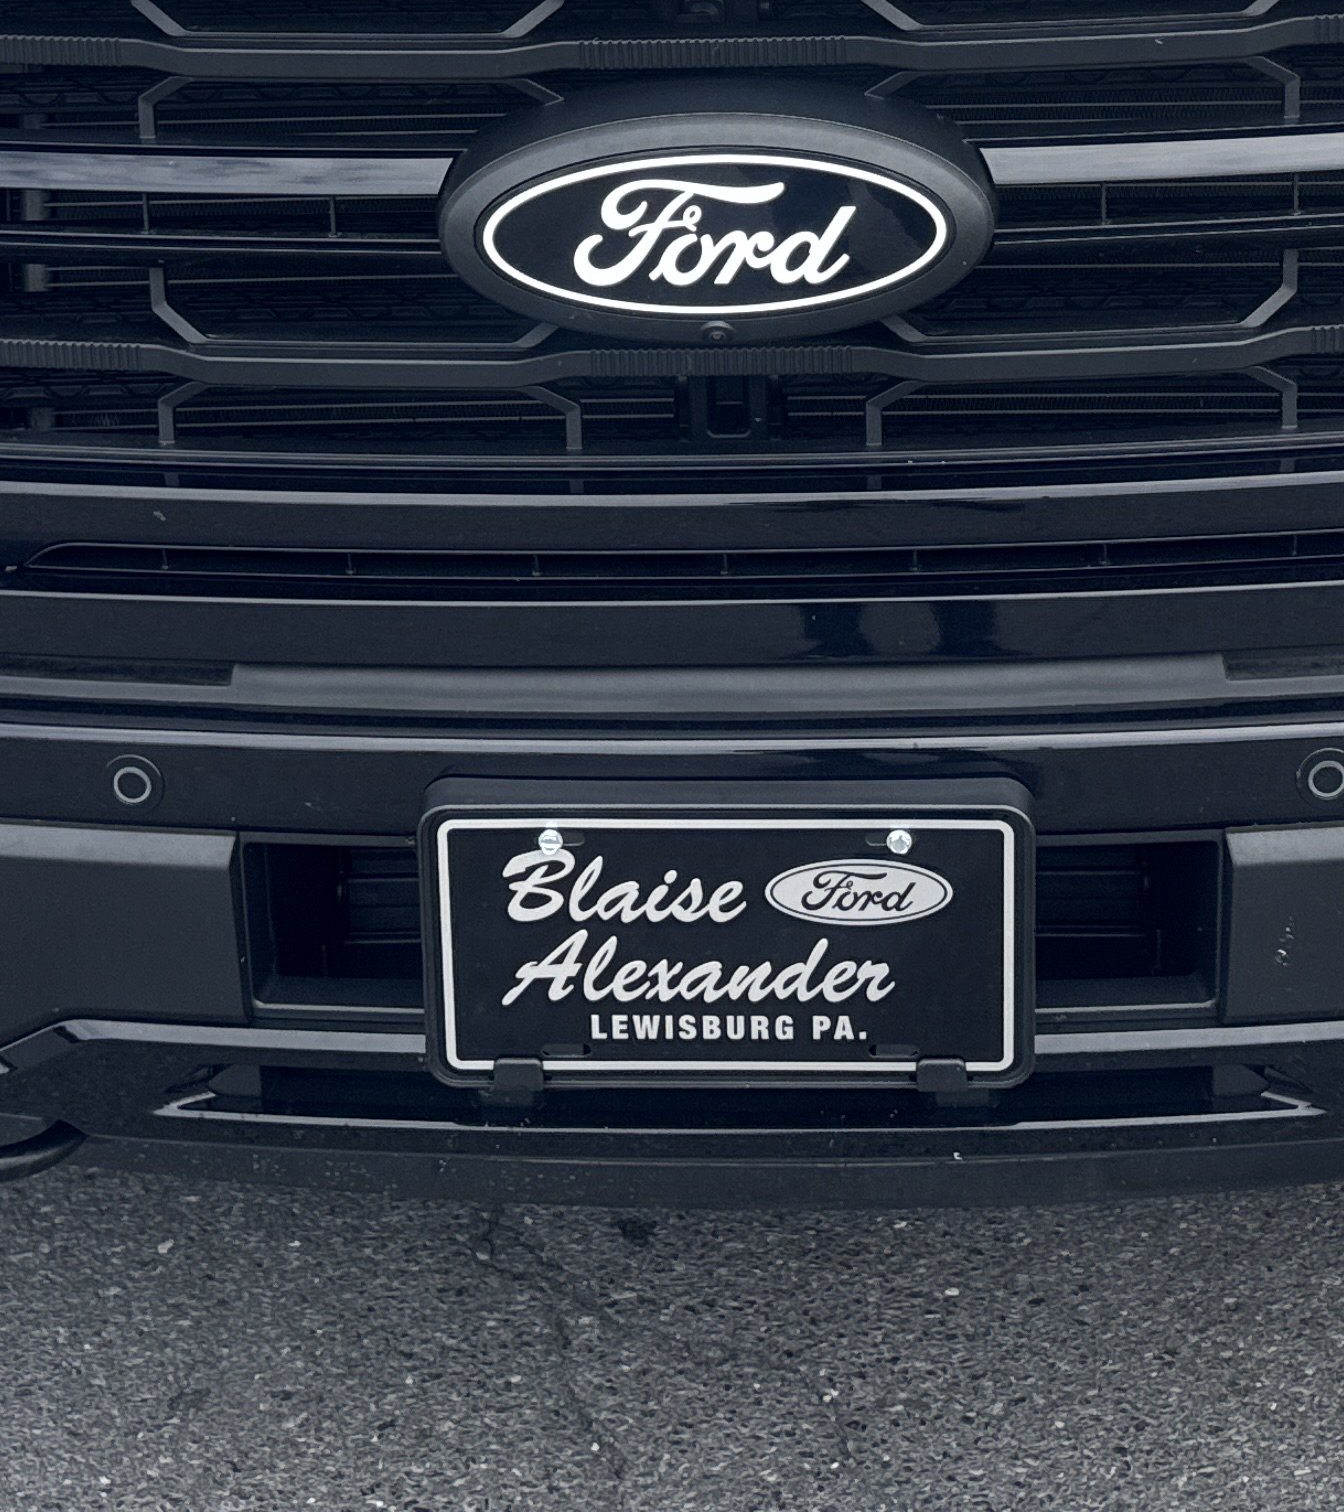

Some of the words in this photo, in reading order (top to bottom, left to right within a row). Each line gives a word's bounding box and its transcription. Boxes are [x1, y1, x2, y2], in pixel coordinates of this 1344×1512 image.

[573, 180, 856, 286] Ford
[502, 849, 746, 923] Blaise
[800, 870, 914, 912] Ford
[501, 929, 895, 1006] Alexander
[590, 1014, 794, 1040] LEWISBURG
[812, 1014, 867, 1040] PA.
